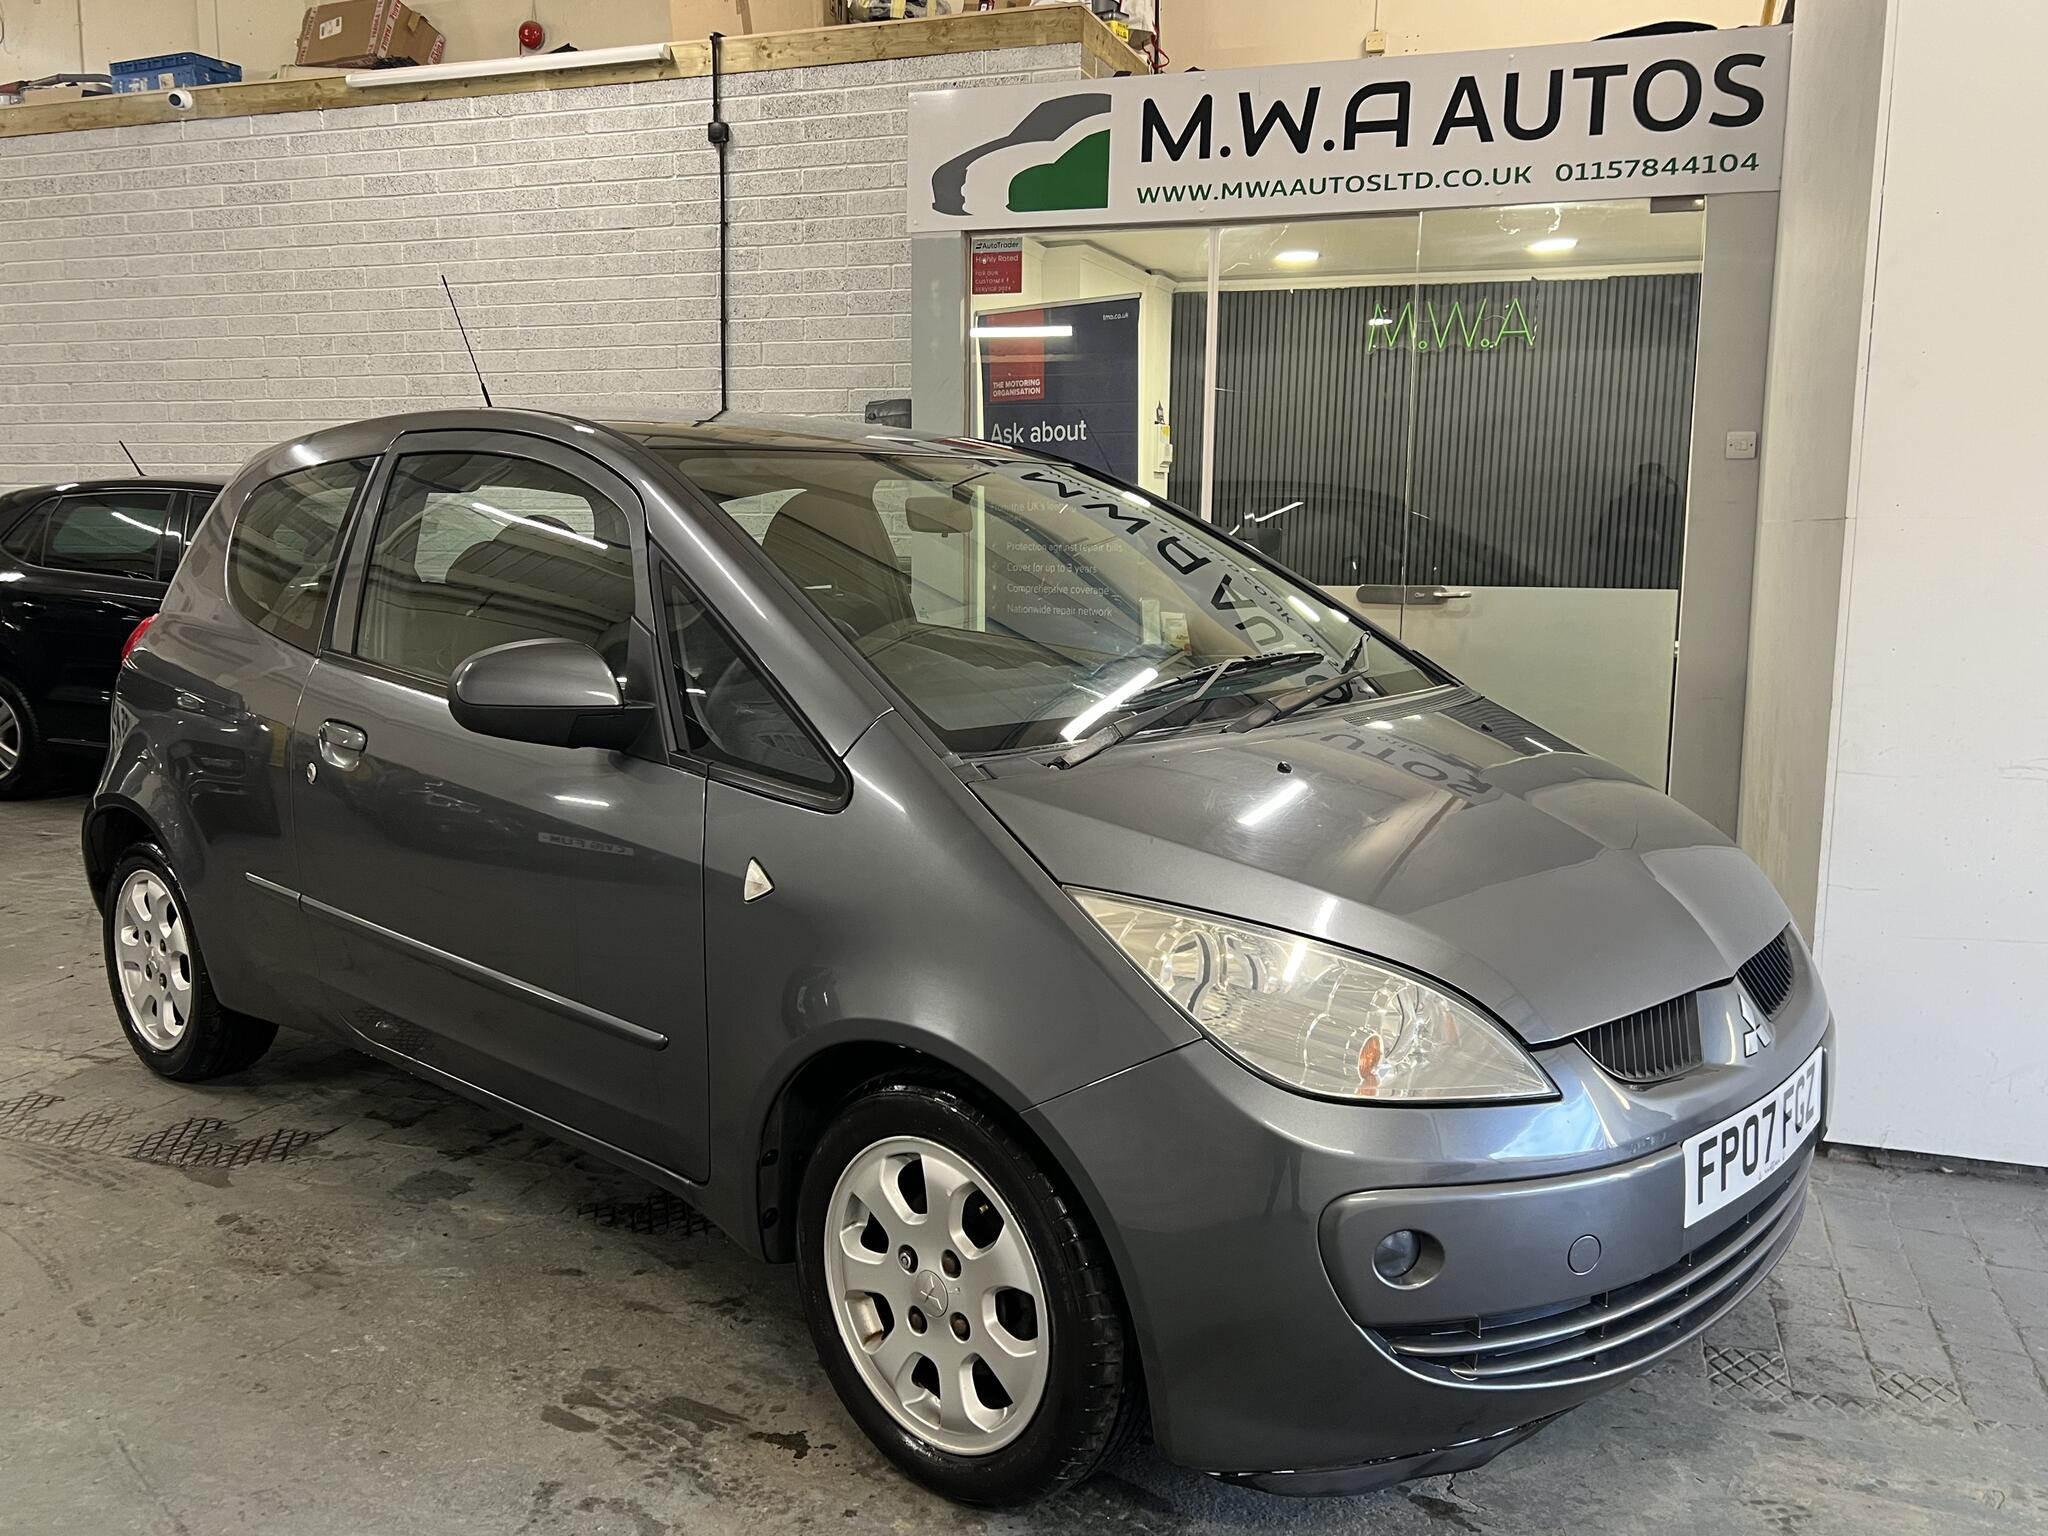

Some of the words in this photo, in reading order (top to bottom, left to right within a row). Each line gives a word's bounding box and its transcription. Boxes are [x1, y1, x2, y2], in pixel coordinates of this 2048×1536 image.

[1140, 80, 1412, 164] M.W.A
[1432, 53, 1767, 146] AUTOS
[1137, 164, 1533, 204] WWW.MWAAUTOSLTD.CO.UK
[1554, 152, 1761, 183] 01157844104
[982, 240, 1019, 249] AutoTrader
[998, 254, 1019, 262] Rated
[1368, 298, 1533, 352] M.W.A
[993, 381, 1005, 389] THE
[1005, 379, 1040, 388] MOTORING
[993, 387, 1041, 397] ORGANISATION
[992, 422, 1025, 444] Ask
[1030, 420, 1087, 444] about
[1006, 543, 1047, 552] Protection
[1006, 563, 1031, 572] Cover
[1033, 562, 1044, 573] for
[1045, 564, 1056, 574] up
[1057, 563, 1065, 573] to
[1075, 564, 1097, 575] years
[1006, 583, 1069, 595] Comprehensive
[1070, 585, 1110, 597] coverage
[1006, 604, 1052, 615] Nationwide
[1053, 605, 1076, 616] repair
[1078, 606, 1113, 617] network
[1697, 1100, 1776, 1205] FP07
[1781, 1063, 1816, 1150] FGZ
